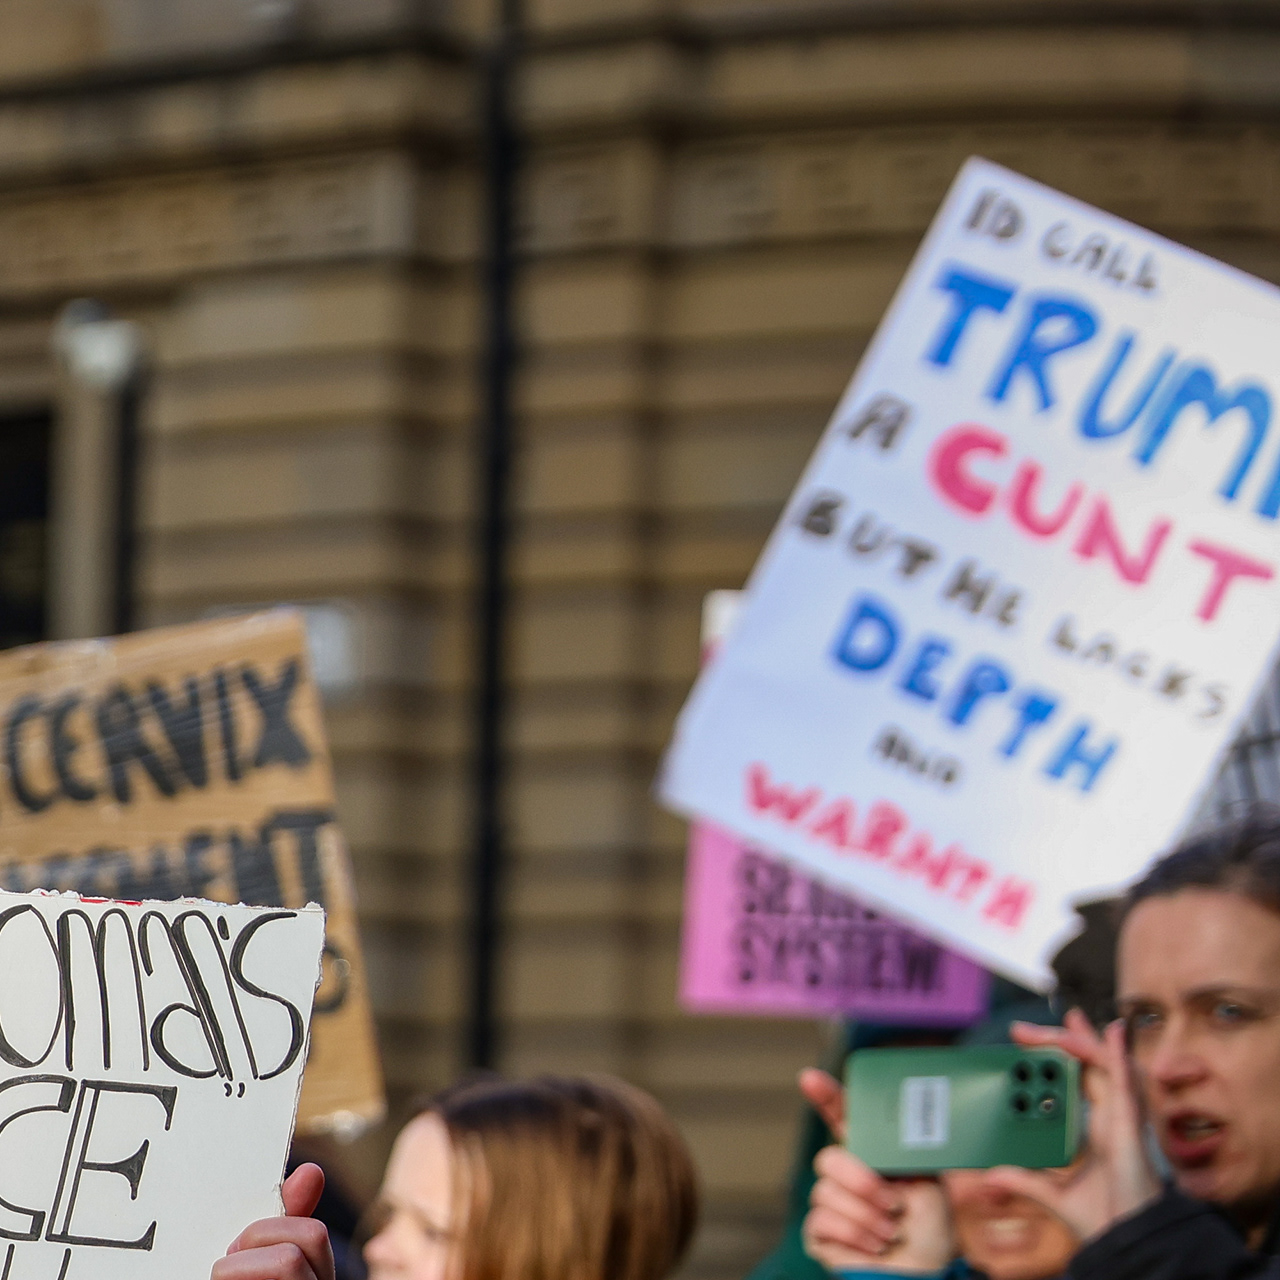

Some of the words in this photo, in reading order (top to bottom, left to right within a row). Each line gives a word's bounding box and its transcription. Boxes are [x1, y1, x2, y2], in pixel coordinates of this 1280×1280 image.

[1042, 220, 1158, 291] CALL
[848, 395, 910, 450] A
[927, 421, 1274, 624] CUNT
[800, 490, 935, 577] BUT
[947, 560, 1022, 627] HE
[1052, 615, 1228, 719] LACKS
[1, 658, 316, 813] CERVIX
[833, 594, 1119, 793] DEPTH
[746, 761, 1037, 931] WARMTH
[737, 919, 944, 993] SYSTEM
